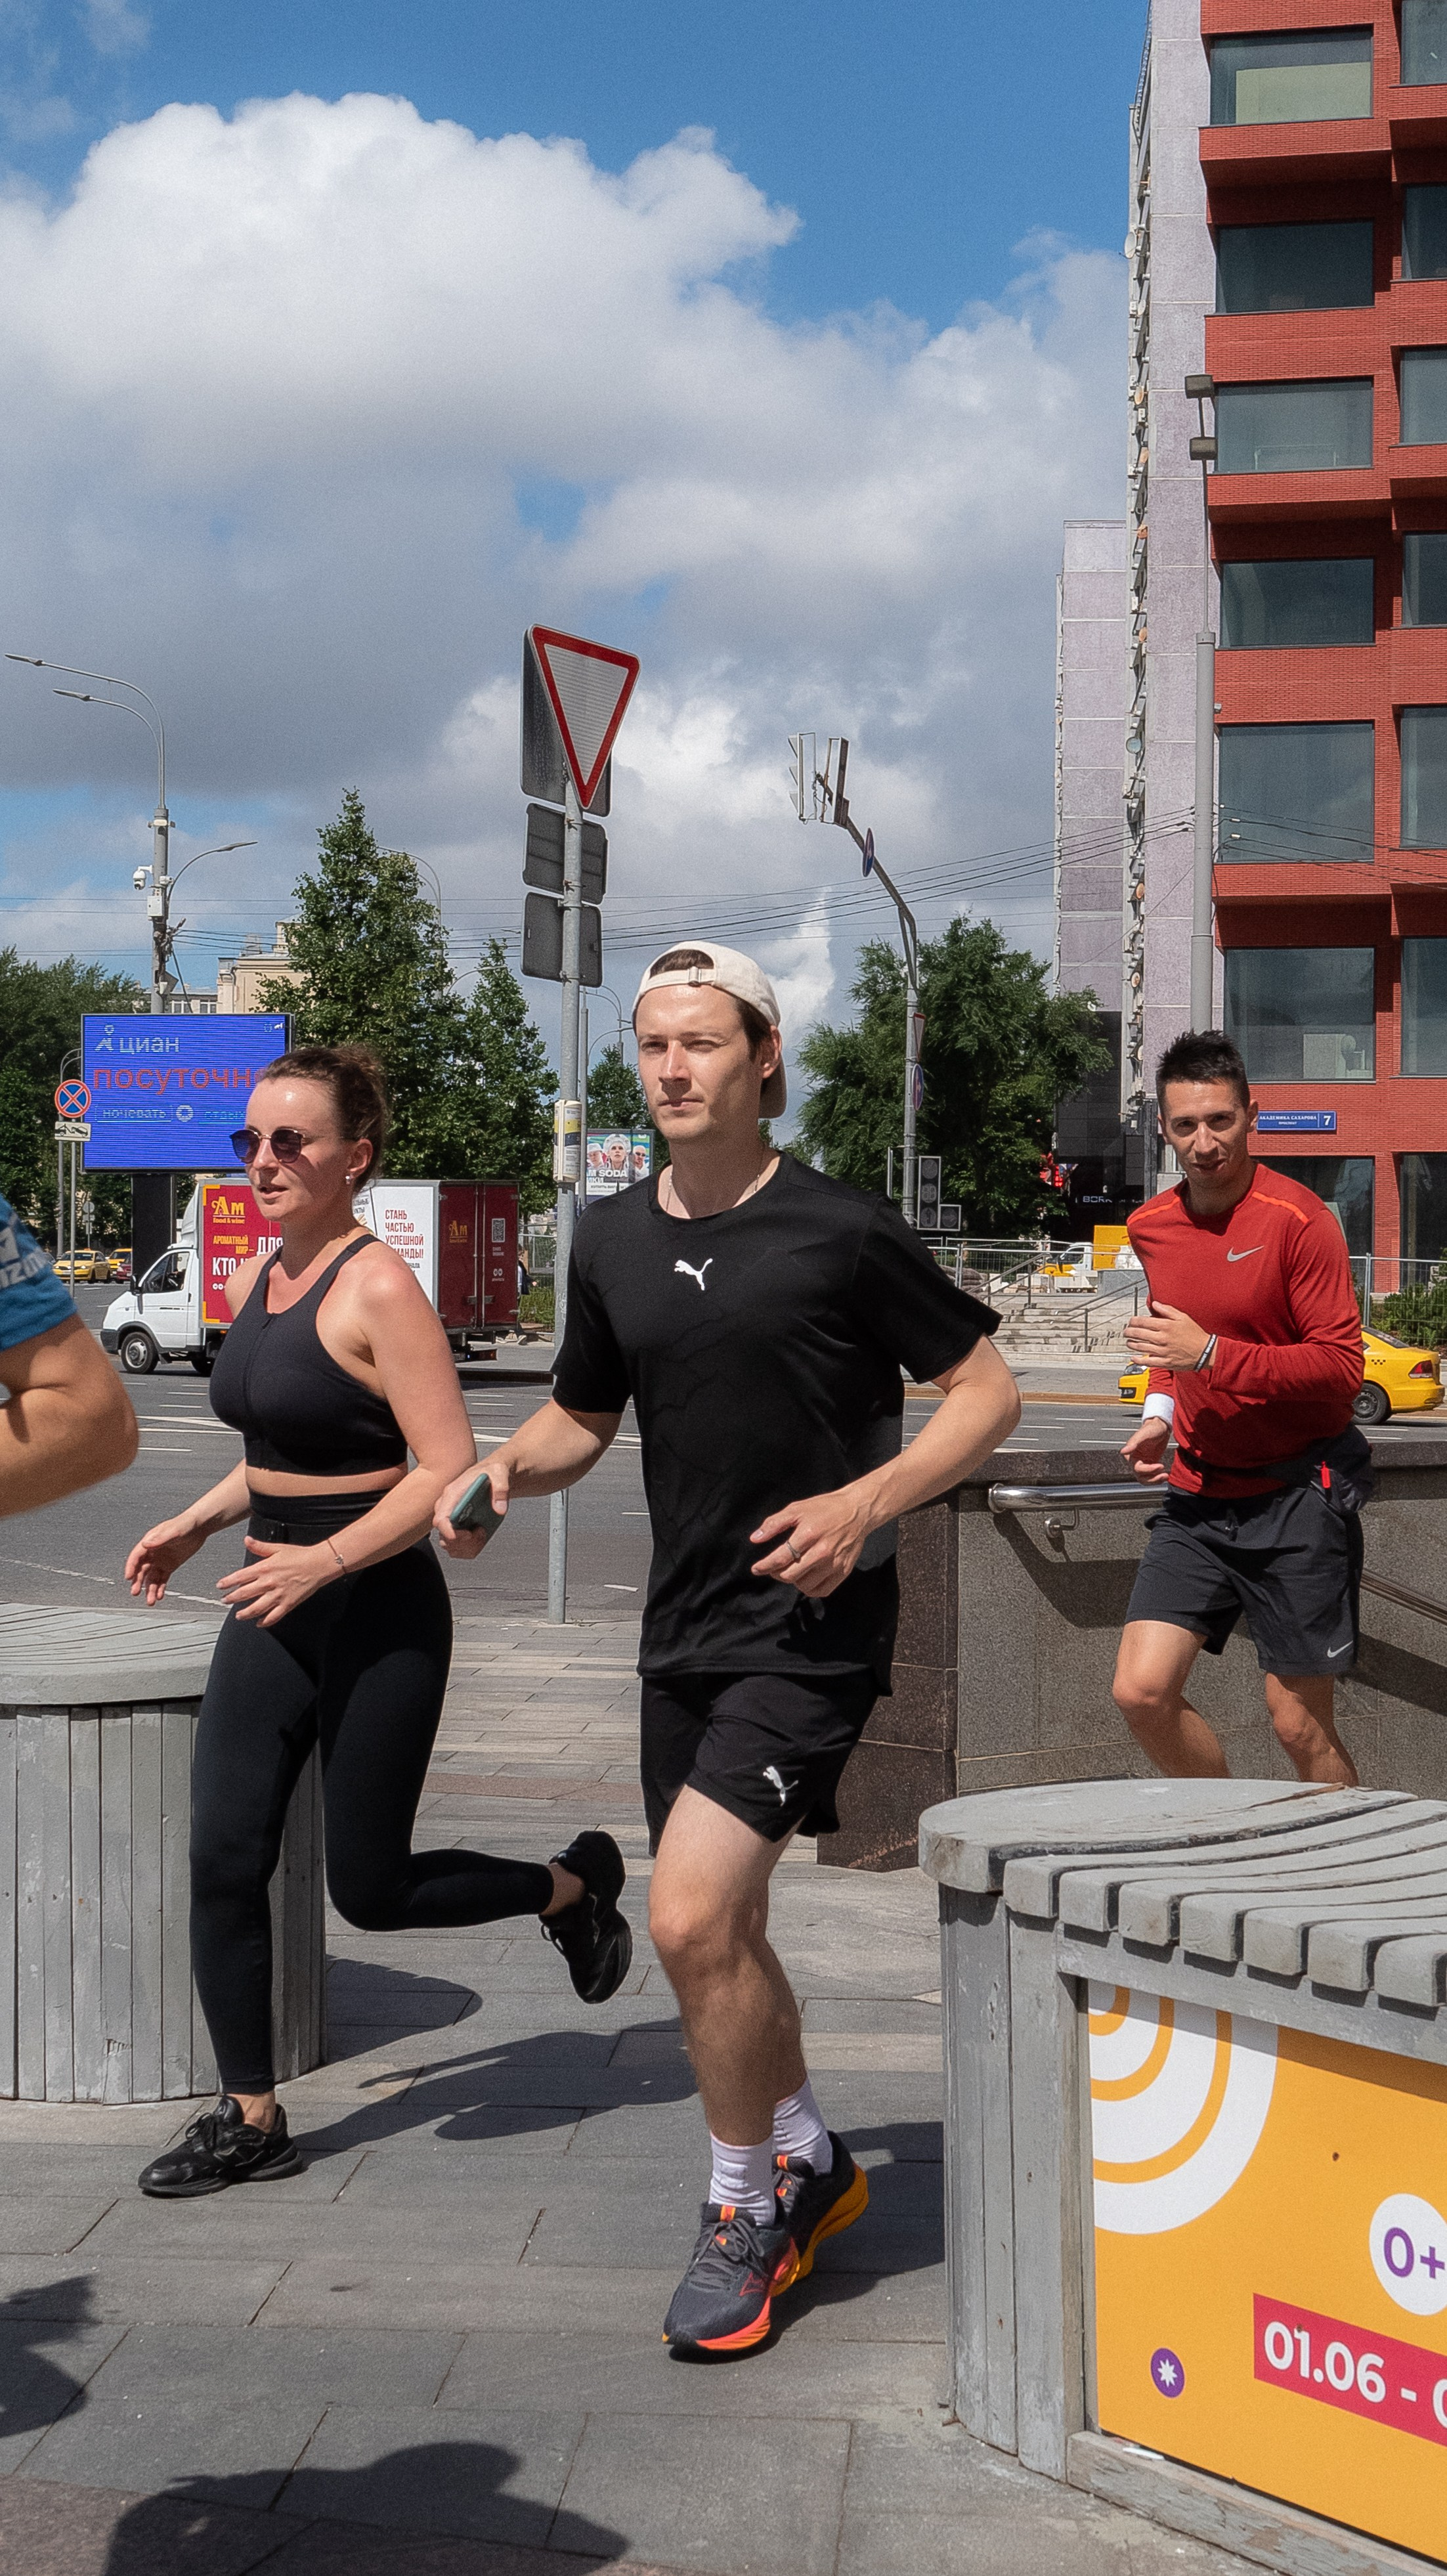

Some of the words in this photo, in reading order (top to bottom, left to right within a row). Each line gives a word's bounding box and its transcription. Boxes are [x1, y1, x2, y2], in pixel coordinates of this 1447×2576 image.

[119, 1037, 179, 1055] циан
[1323, 1115, 1331, 1125] 7
[385, 1210, 407, 1219] СТАНЬ
[385, 1222, 414, 1233] ЧАСТЬЮ
[213, 1234, 248, 1245] АРОМАТНЫЙ
[257, 1236, 284, 1255] ДЛЯ
[385, 1234, 424, 1246] УСПЕШНОЙ
[212, 1257, 236, 1276] КТО
[1383, 2227, 1445, 2279] 0+
[1264, 2321, 1387, 2403] 01.06
